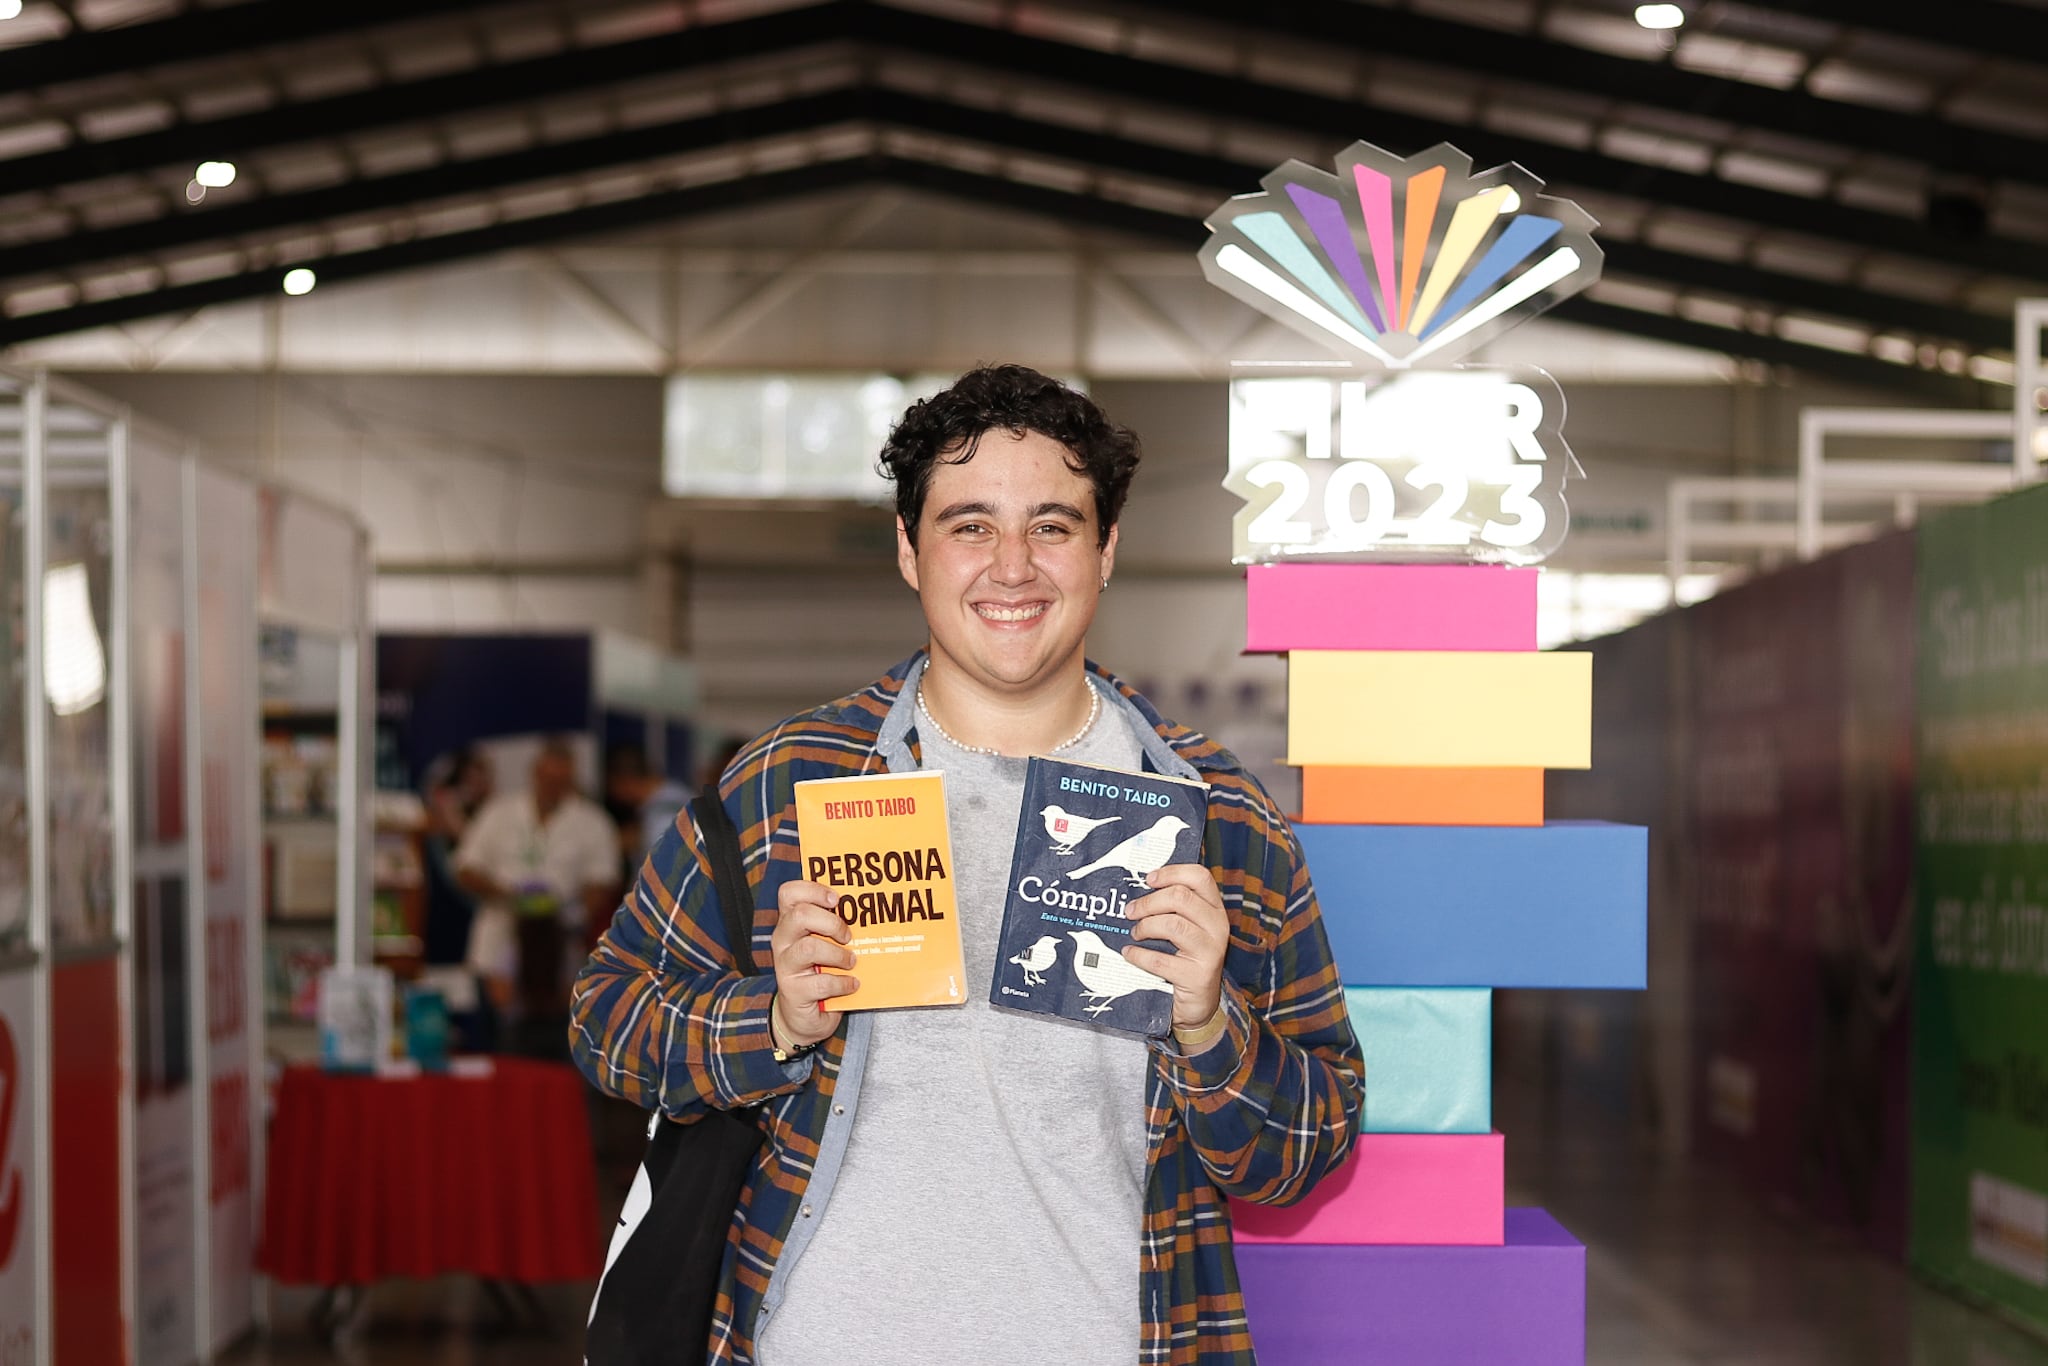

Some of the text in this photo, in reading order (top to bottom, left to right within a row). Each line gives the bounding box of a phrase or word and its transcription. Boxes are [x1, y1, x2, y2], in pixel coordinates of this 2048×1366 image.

[1244, 381, 1547, 460] FILR
[1245, 460, 1547, 547] 2023
[825, 797, 916, 820] BENITO TAIBO
[1060, 777, 1171, 808] BENITO TAIBO
[808, 847, 946, 887] PERSONA
[822, 888, 944, 927] ORMAL
[1018, 876, 1127, 920] Cómpli
[1084, 922, 1120, 933] aventura
